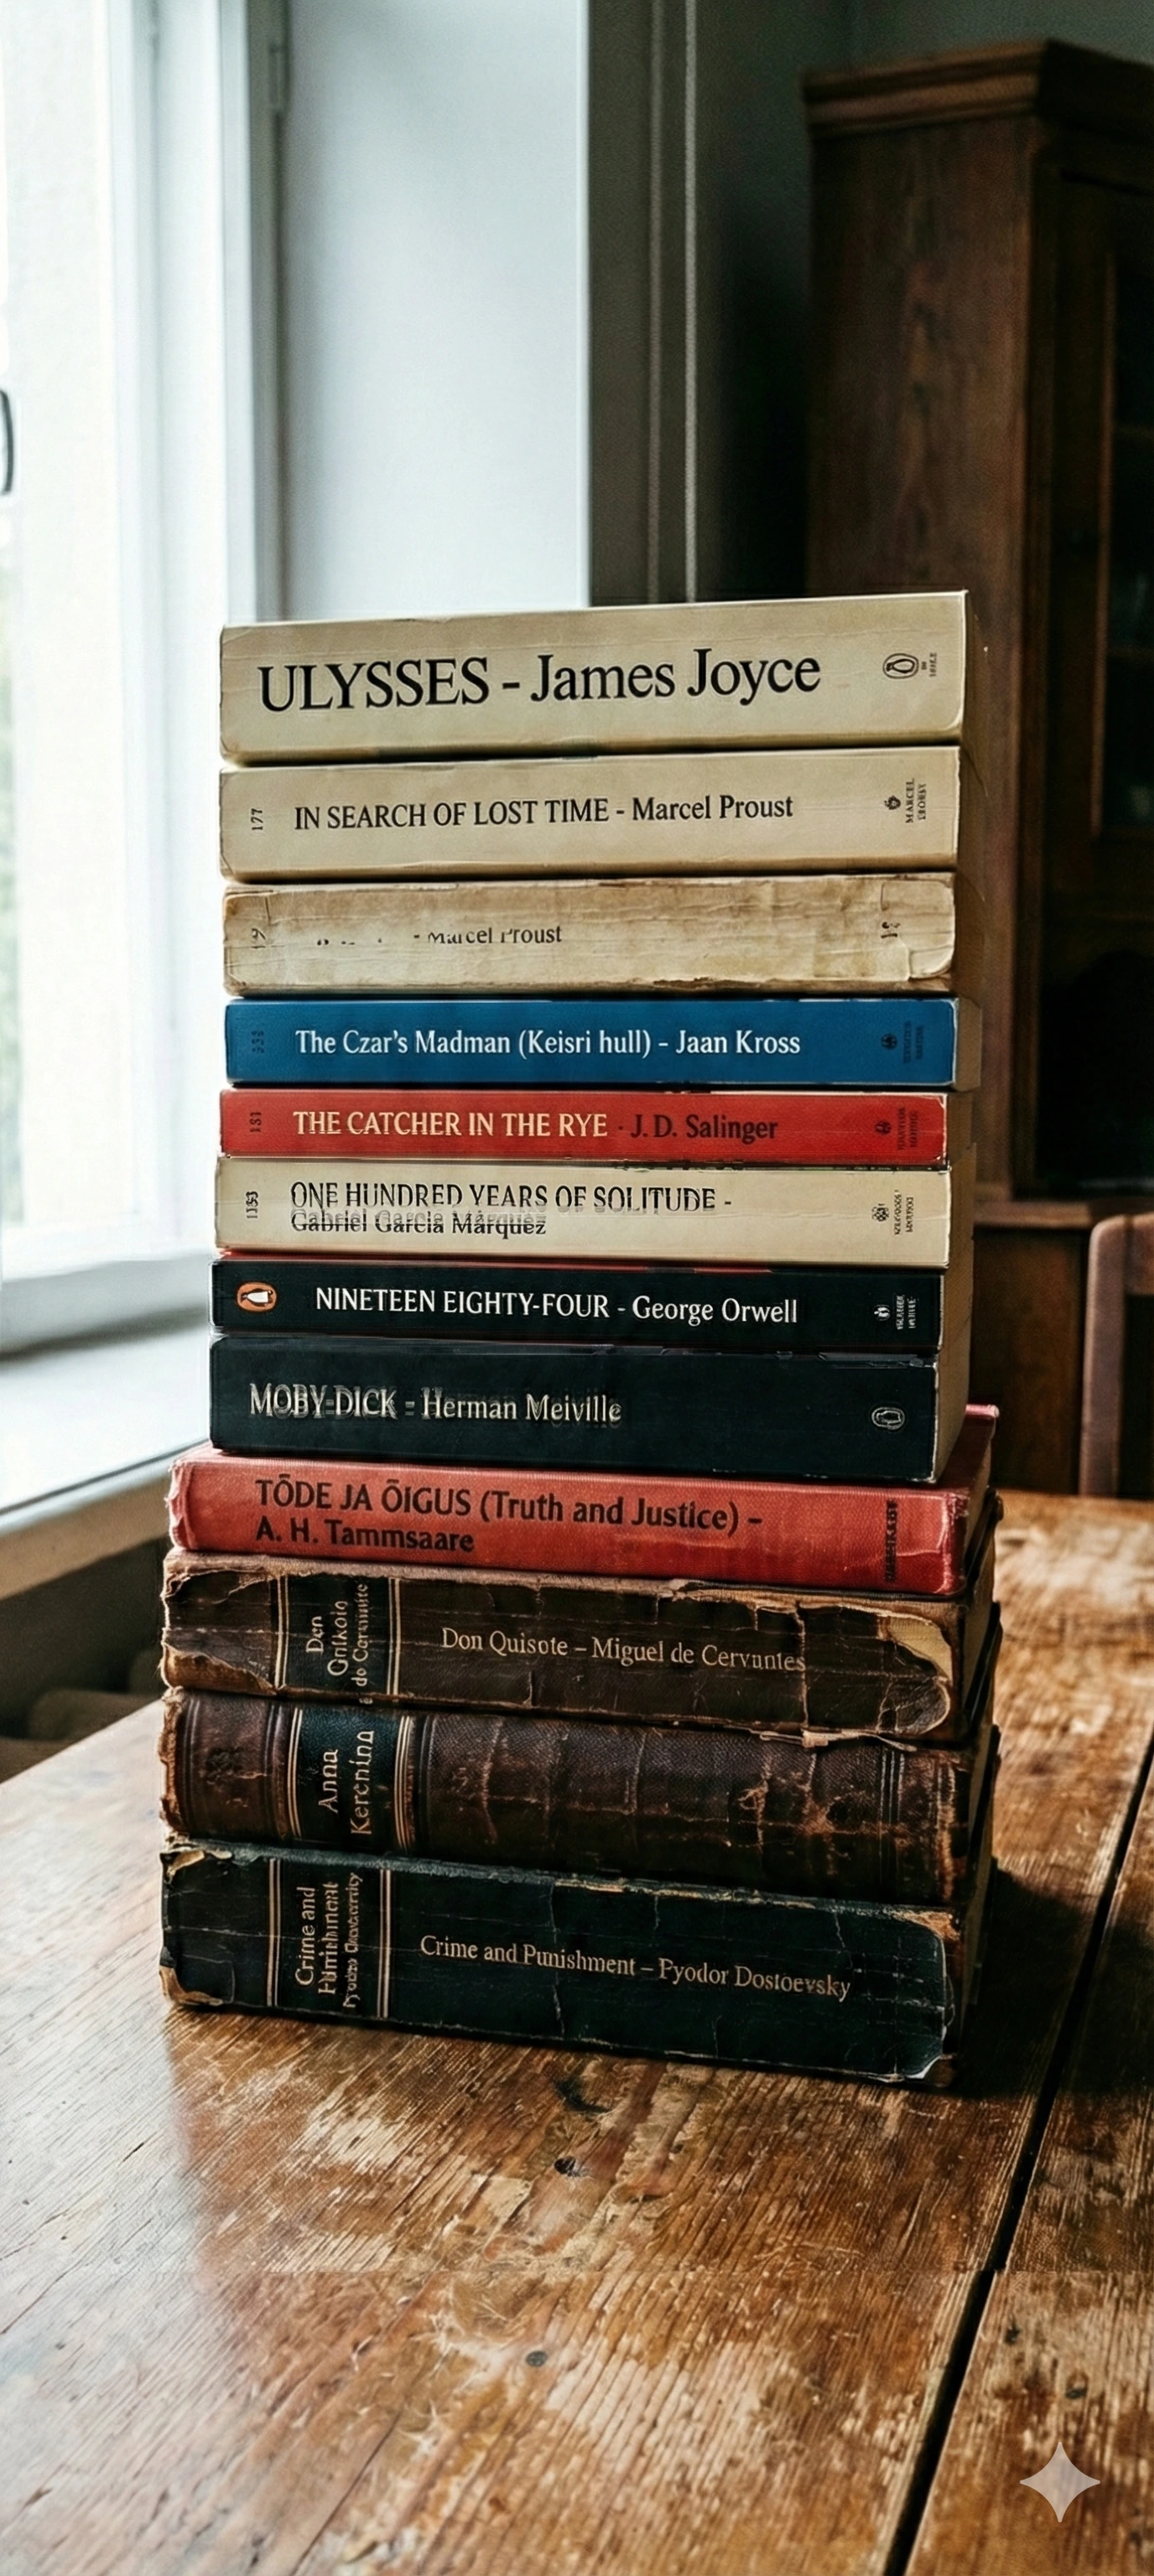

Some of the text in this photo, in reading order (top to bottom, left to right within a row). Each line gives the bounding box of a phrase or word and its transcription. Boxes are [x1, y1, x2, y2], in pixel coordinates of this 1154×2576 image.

[257, 657, 489, 712] ULYSSES
[531, 655, 675, 701] James
[688, 648, 820, 705] Joyce
[294, 807, 320, 830] IN
[328, 803, 426, 828] SEARCH
[434, 802, 466, 826] OF
[475, 801, 538, 825] LOST
[544, 798, 609, 823] TIME
[633, 795, 711, 820] Marcel
[720, 795, 793, 818] Proust
[295, 1031, 335, 1053] The
[416, 1030, 510, 1053] Madman
[519, 1031, 590, 1059] (Keisri
[600, 1030, 650, 1058] hull)
[676, 1031, 727, 1053] Jaan
[736, 1031, 800, 1053] Kross
[293, 1112, 340, 1134] THE
[347, 1112, 461, 1135] CATCHER
[470, 1113, 493, 1135] IN
[502, 1114, 550, 1136] THE
[559, 1114, 607, 1136] RYE
[685, 1114, 778, 1145] Salinger
[291, 1182, 339, 1208] ONE
[346, 1183, 462, 1207] HUNDRED
[470, 1185, 547, 1208] YEARS
[556, 1186, 586, 1207] OF
[594, 1187, 715, 1211] SOLITUDE
[291, 1210, 367, 1233] Gabriel
[317, 1288, 434, 1311] NINETEEN
[444, 1291, 609, 1317] EIGHTY-FOUR
[632, 1296, 713, 1326] George
[722, 1298, 797, 1322] Orwell
[422, 1388, 517, 1419] Herman
[340, 1483, 372, 1510] JA
[481, 1491, 563, 1523] (Truth
[573, 1497, 623, 1524] and
[632, 1498, 738, 1535] Justice)
[255, 1516, 473, 1552] A. H. Tammsaare
[440, 1628, 483, 1650] Don
[591, 1637, 663, 1666] Miguel
[671, 1643, 694, 1664] de
[319, 1749, 338, 1813] Anna
[295, 1887, 315, 1985] Crime and
[421, 1935, 478, 1959] Crime
[484, 1944, 517, 1963] and
[523, 1945, 635, 1976] Punishment
